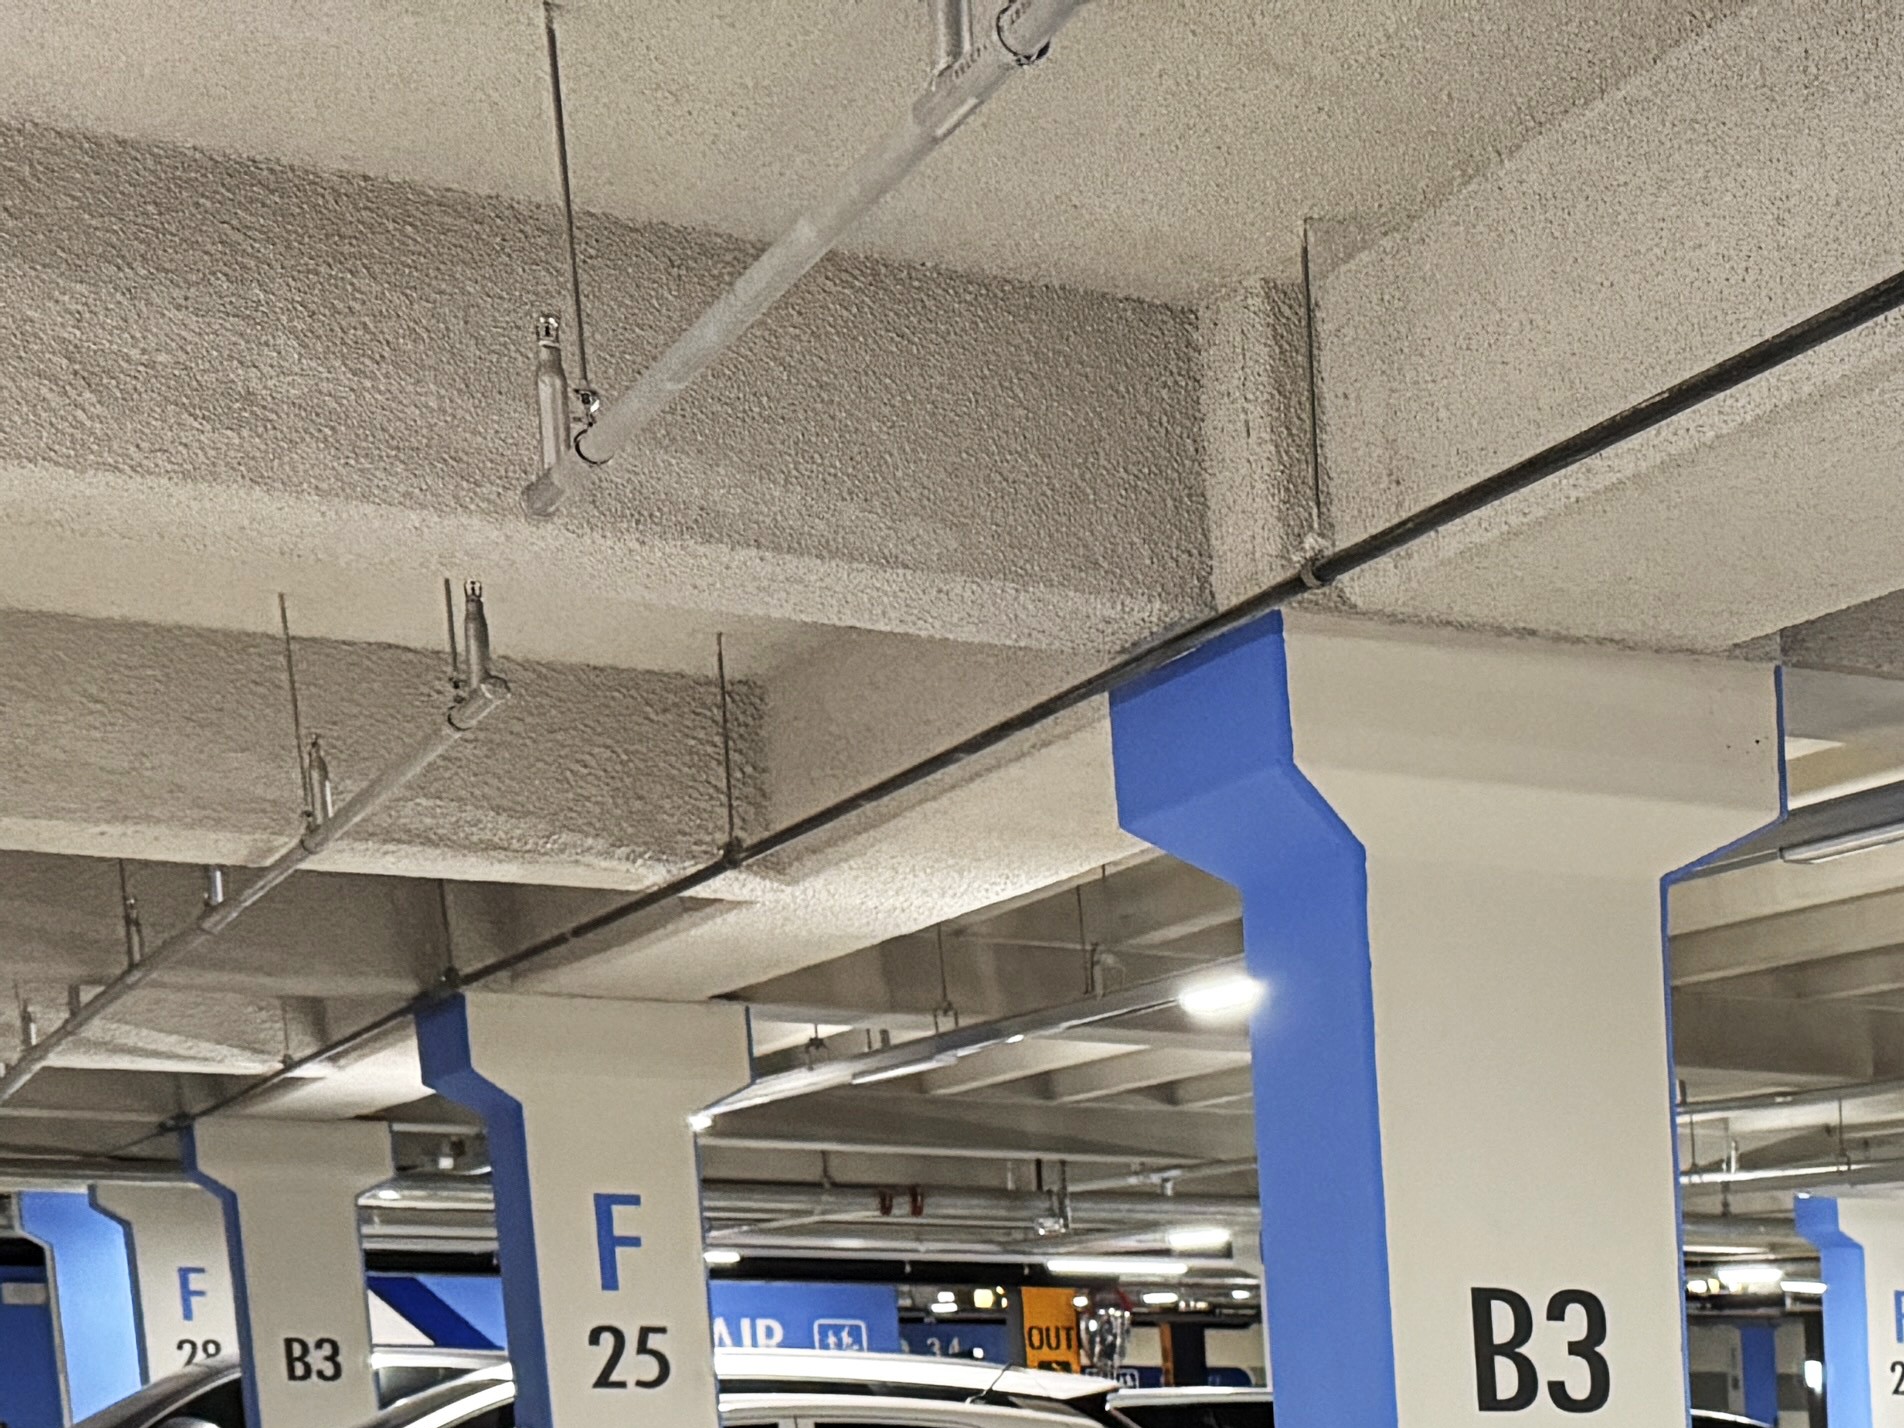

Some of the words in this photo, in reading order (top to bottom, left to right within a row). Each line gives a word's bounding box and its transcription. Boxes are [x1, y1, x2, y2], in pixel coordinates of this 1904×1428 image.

[593, 1193, 642, 1291] F
[177, 1266, 207, 1321] F
[283, 1337, 343, 1382] B3
[588, 1325, 671, 1389] 25
[1027, 1325, 1075, 1350] OUT
[1470, 1286, 1611, 1413] B3
